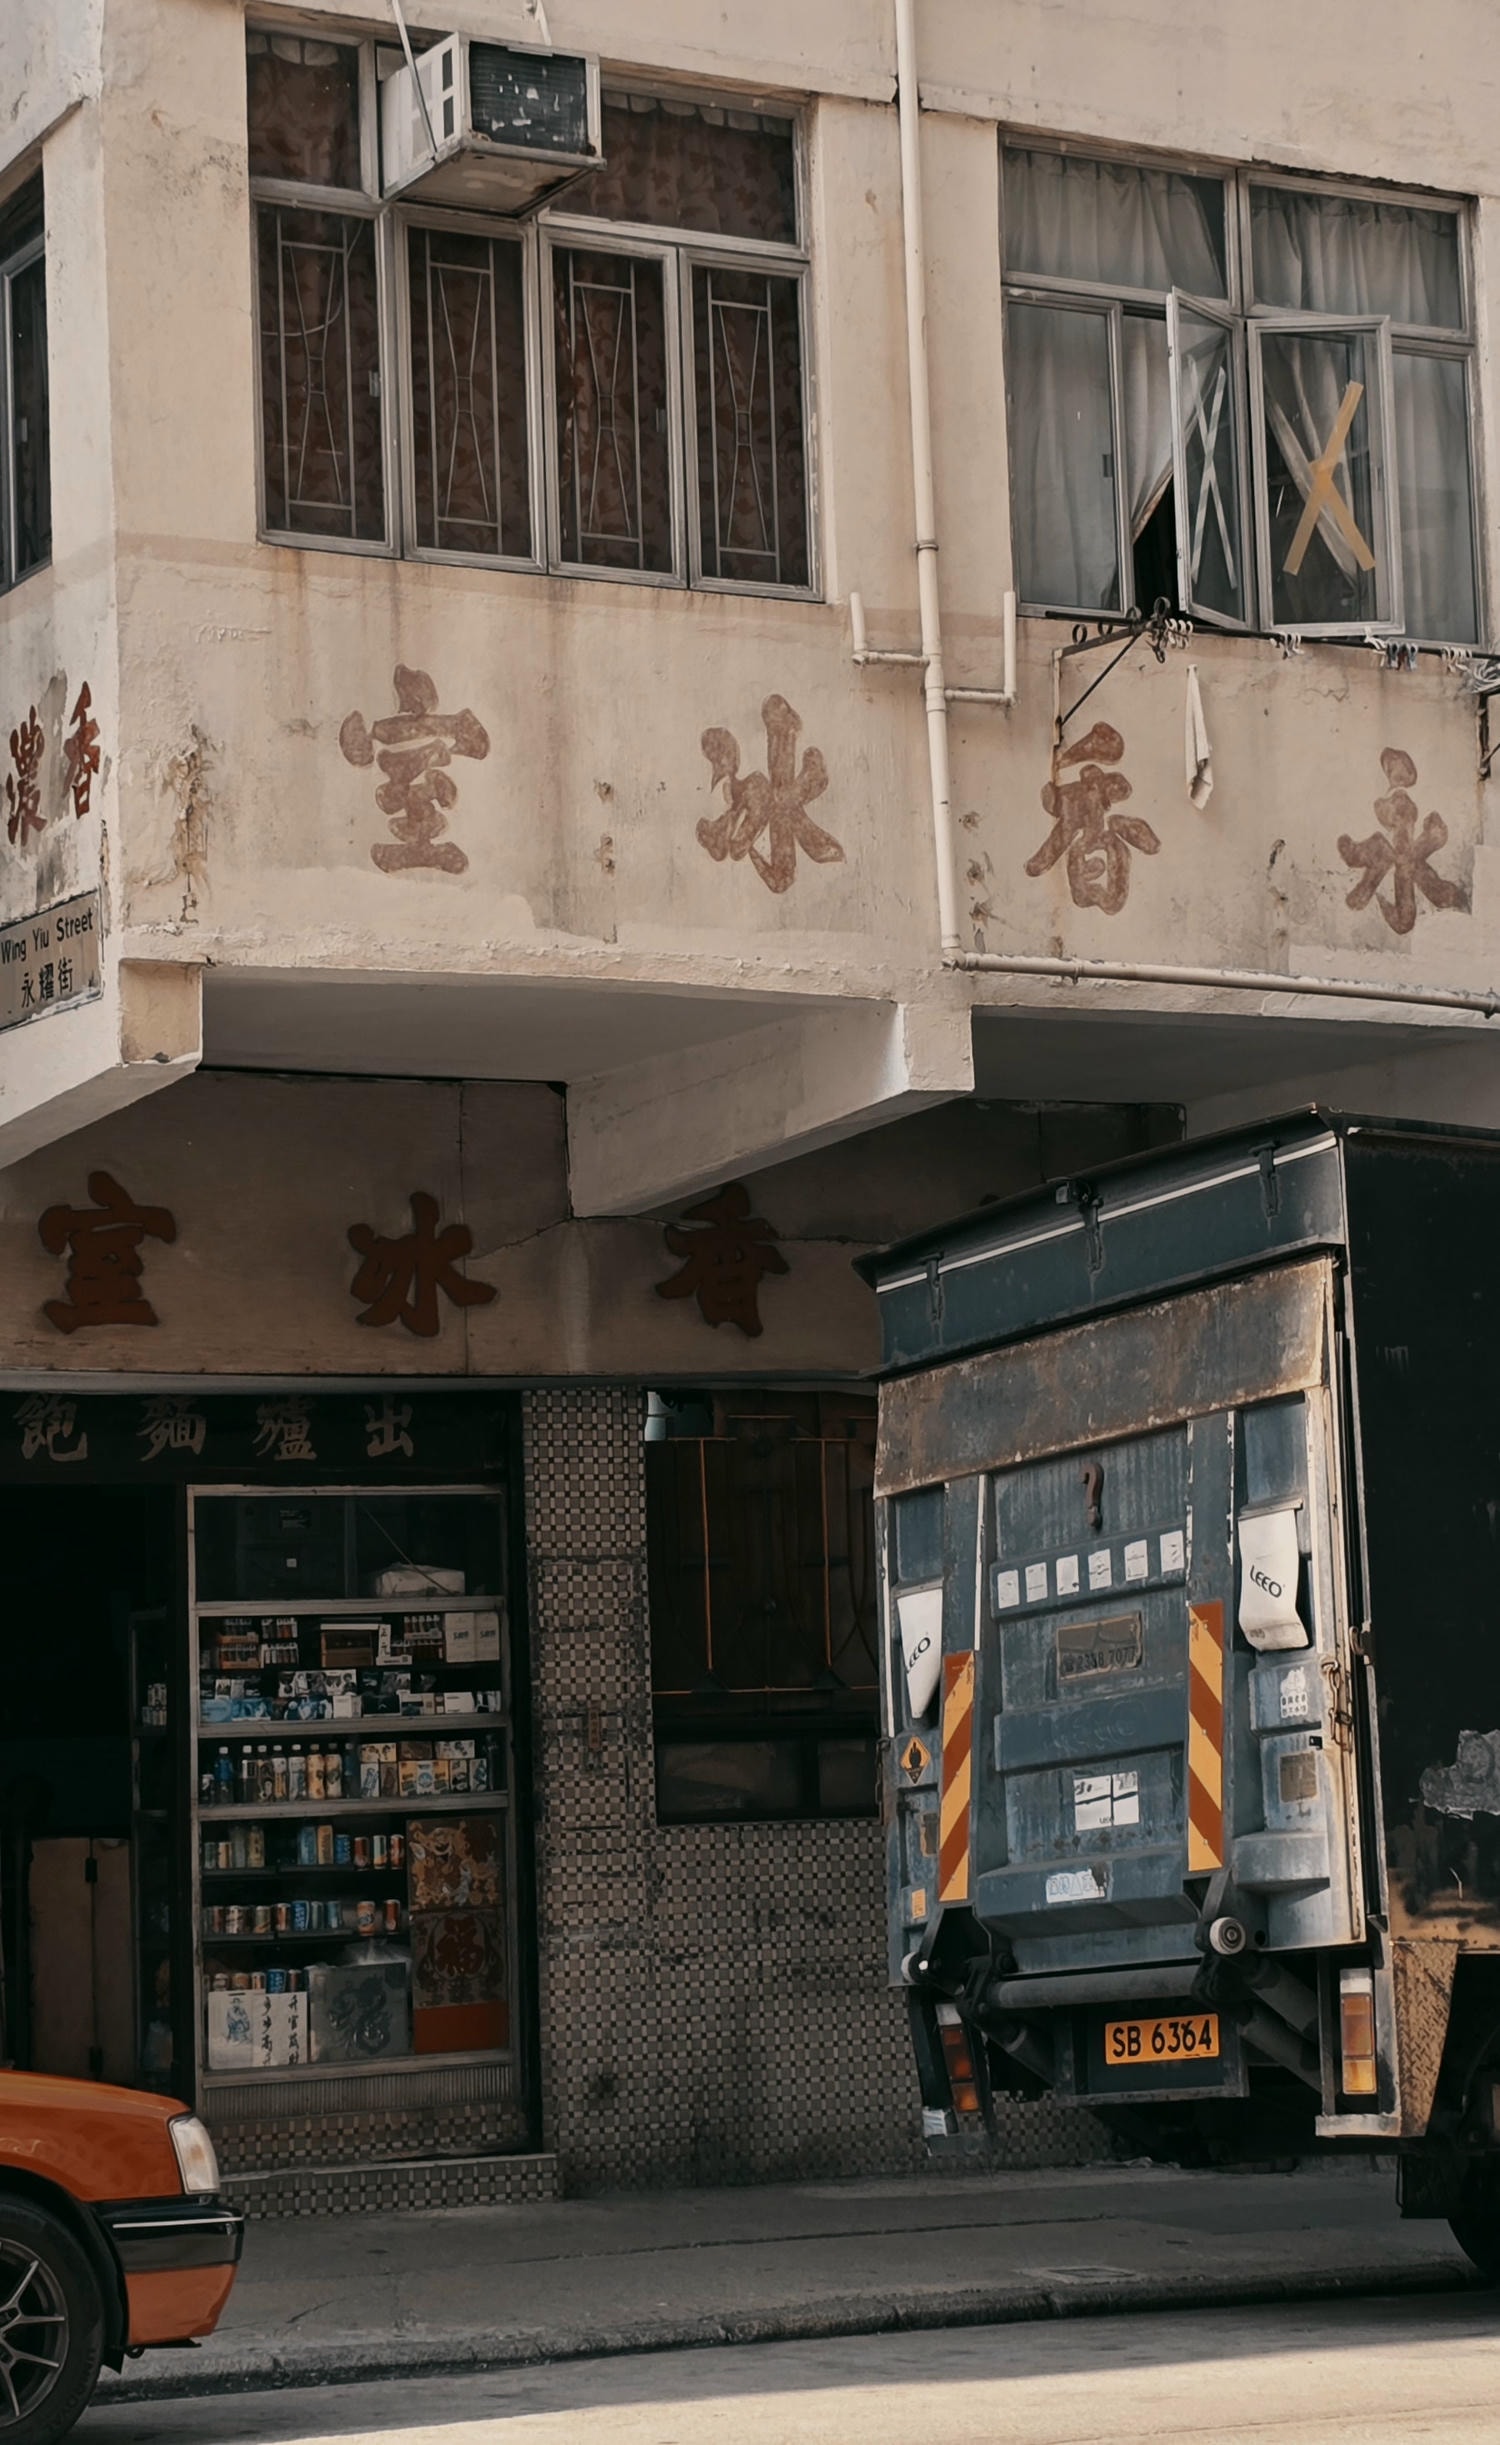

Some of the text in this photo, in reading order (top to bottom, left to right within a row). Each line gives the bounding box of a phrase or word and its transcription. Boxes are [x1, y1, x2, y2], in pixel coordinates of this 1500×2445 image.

[1, 907, 93, 964] Wing Yiu Street
[21, 956, 73, 1009] 永耀街
[1249, 1563, 1283, 1599] LEEO
[1112, 2018, 1213, 2058] SB 6364
